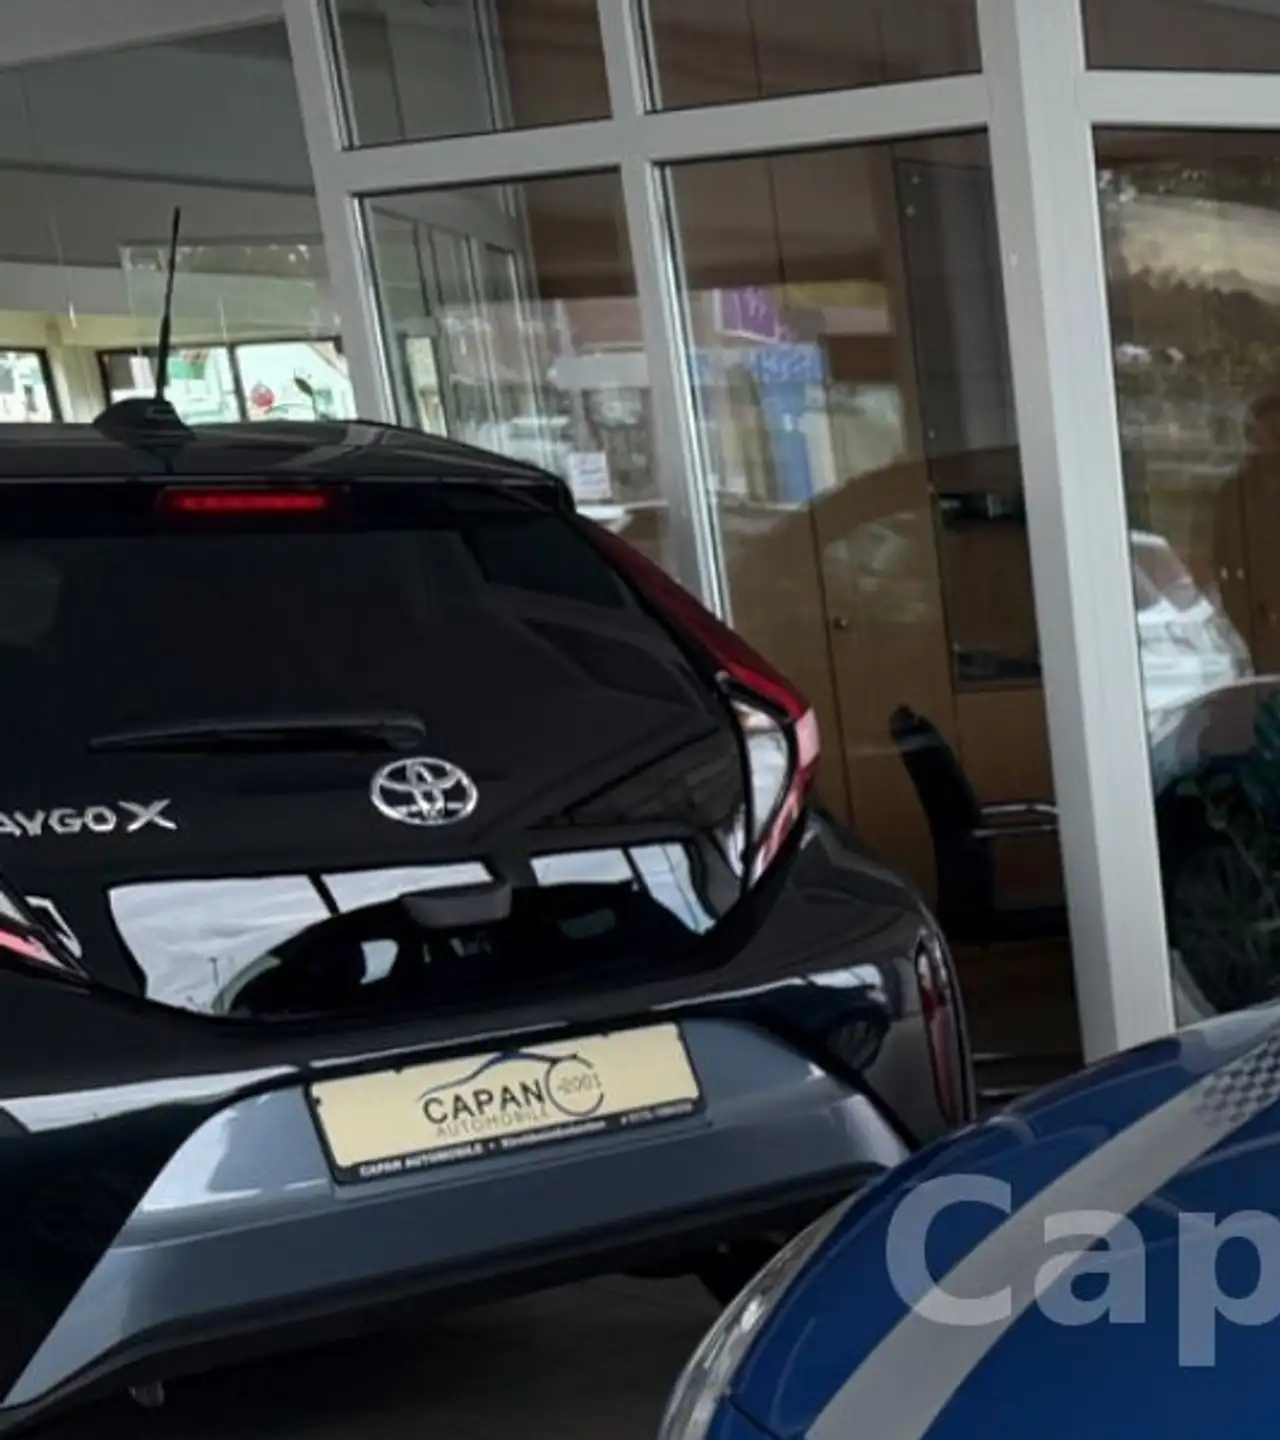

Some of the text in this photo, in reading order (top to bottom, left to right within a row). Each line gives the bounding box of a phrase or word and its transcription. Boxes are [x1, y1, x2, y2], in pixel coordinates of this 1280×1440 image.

[117, 798, 178, 833] X
[422, 1078, 545, 1125] CAPAN
[435, 1108, 551, 1138] AUTOMOBILE
